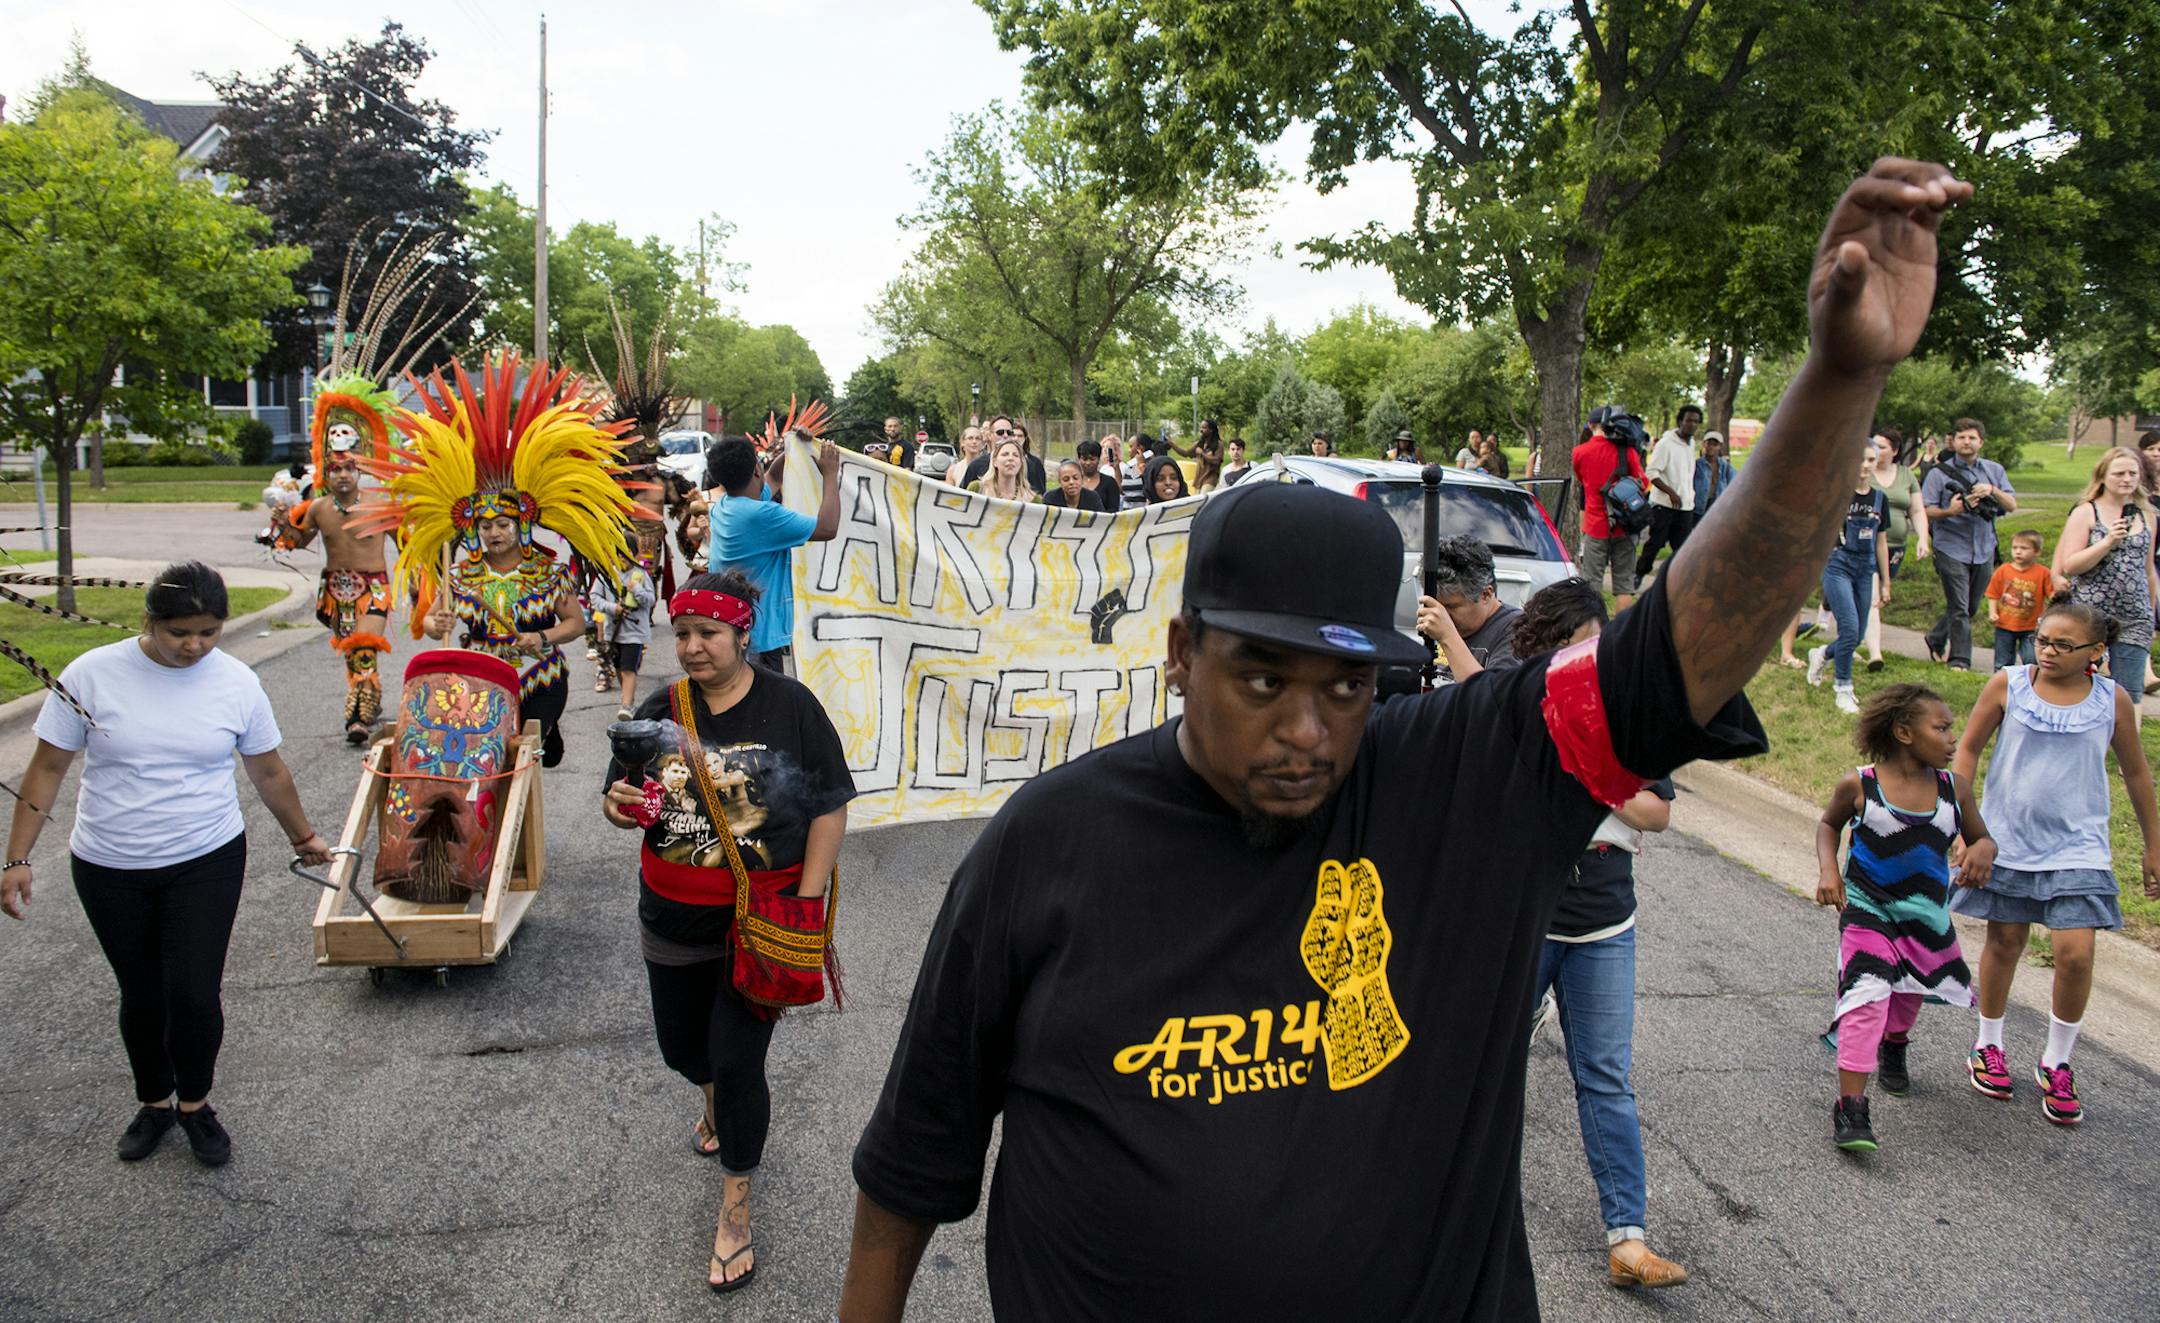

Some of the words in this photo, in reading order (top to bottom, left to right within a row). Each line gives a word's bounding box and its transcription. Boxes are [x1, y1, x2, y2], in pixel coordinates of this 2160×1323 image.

[812, 612, 1184, 793] JUSTI
[1148, 1067, 1201, 1098] for
[1208, 1057, 1313, 1105] justic
